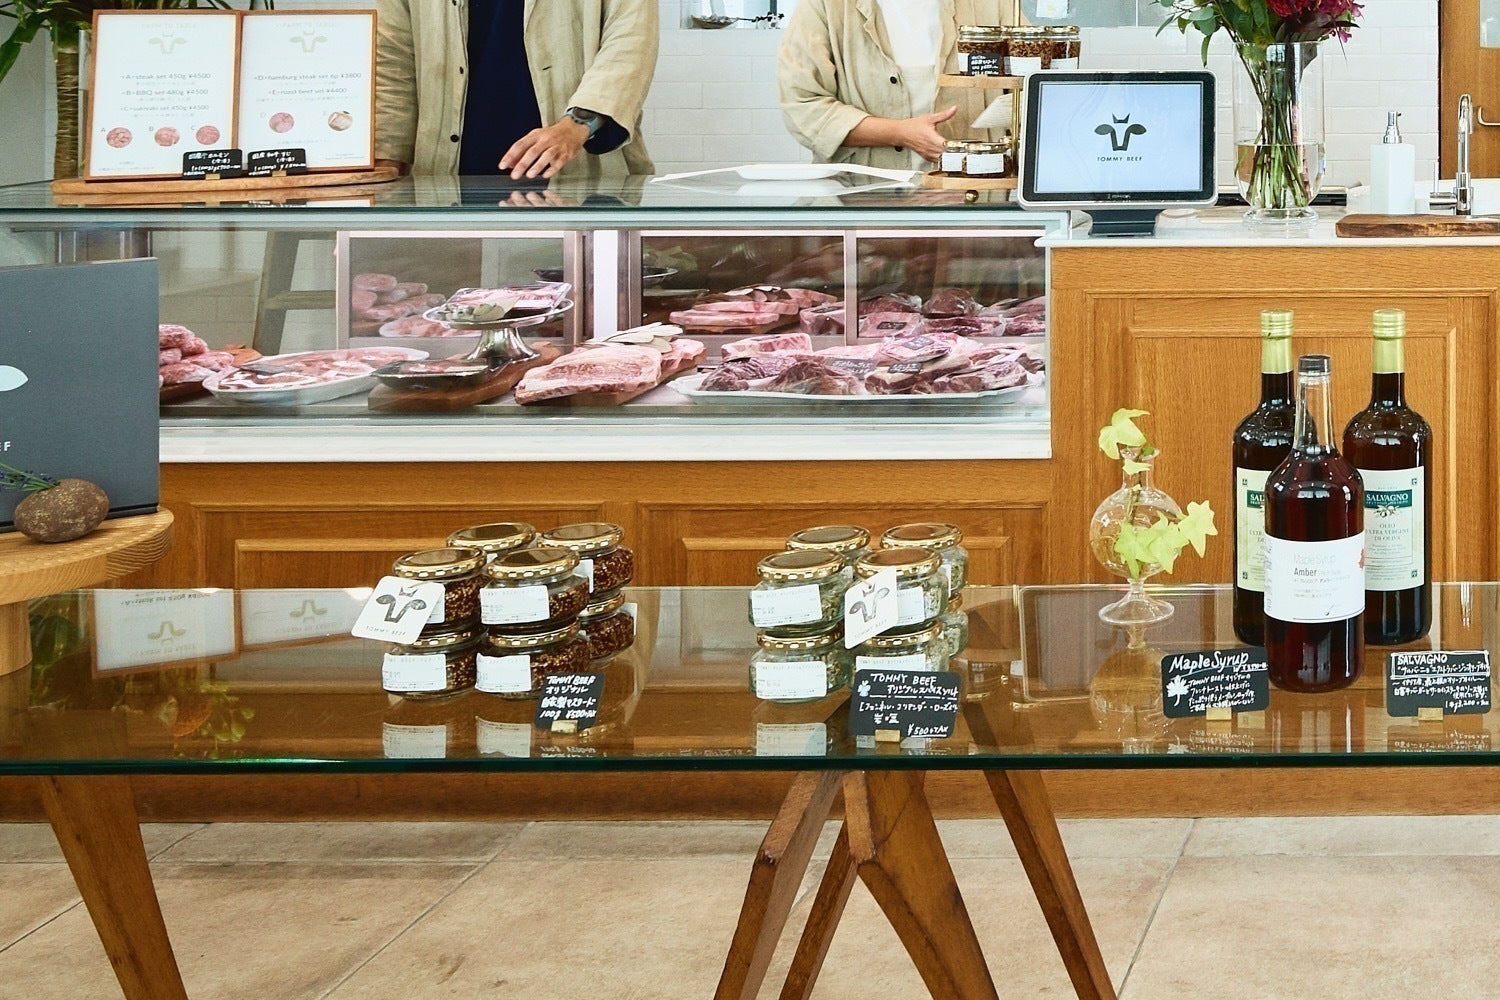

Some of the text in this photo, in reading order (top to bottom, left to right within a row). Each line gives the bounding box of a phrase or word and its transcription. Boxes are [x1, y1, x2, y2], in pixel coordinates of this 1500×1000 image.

[1366, 493, 1408, 501] SALVAGNO
[1294, 567, 1317, 577] Amber
[1168, 651, 1249, 674] Maple Syrup
[1397, 654, 1448, 666] SALVAGNO
[870, 673, 937, 688] TOMMY BEEF
